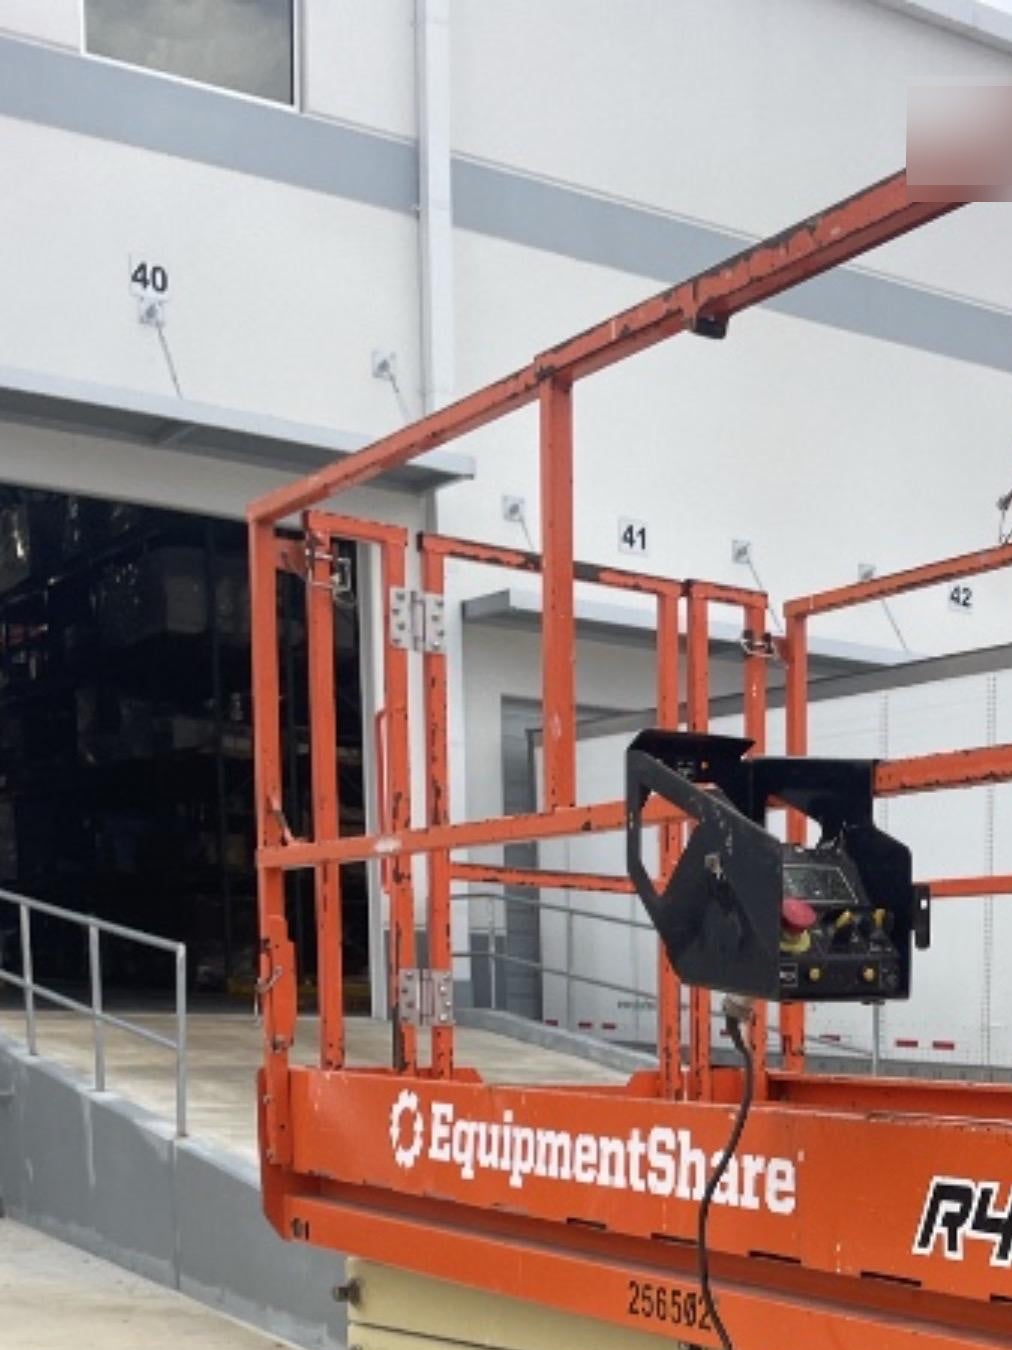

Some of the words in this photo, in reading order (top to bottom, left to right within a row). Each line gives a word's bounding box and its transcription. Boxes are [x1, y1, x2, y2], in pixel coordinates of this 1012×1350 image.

[131, 262, 168, 292] 40
[622, 524, 647, 550] 41
[949, 586, 973, 608] 42
[428, 1102, 798, 1215] EquipmentShare
[627, 1280, 712, 1331] 256502
